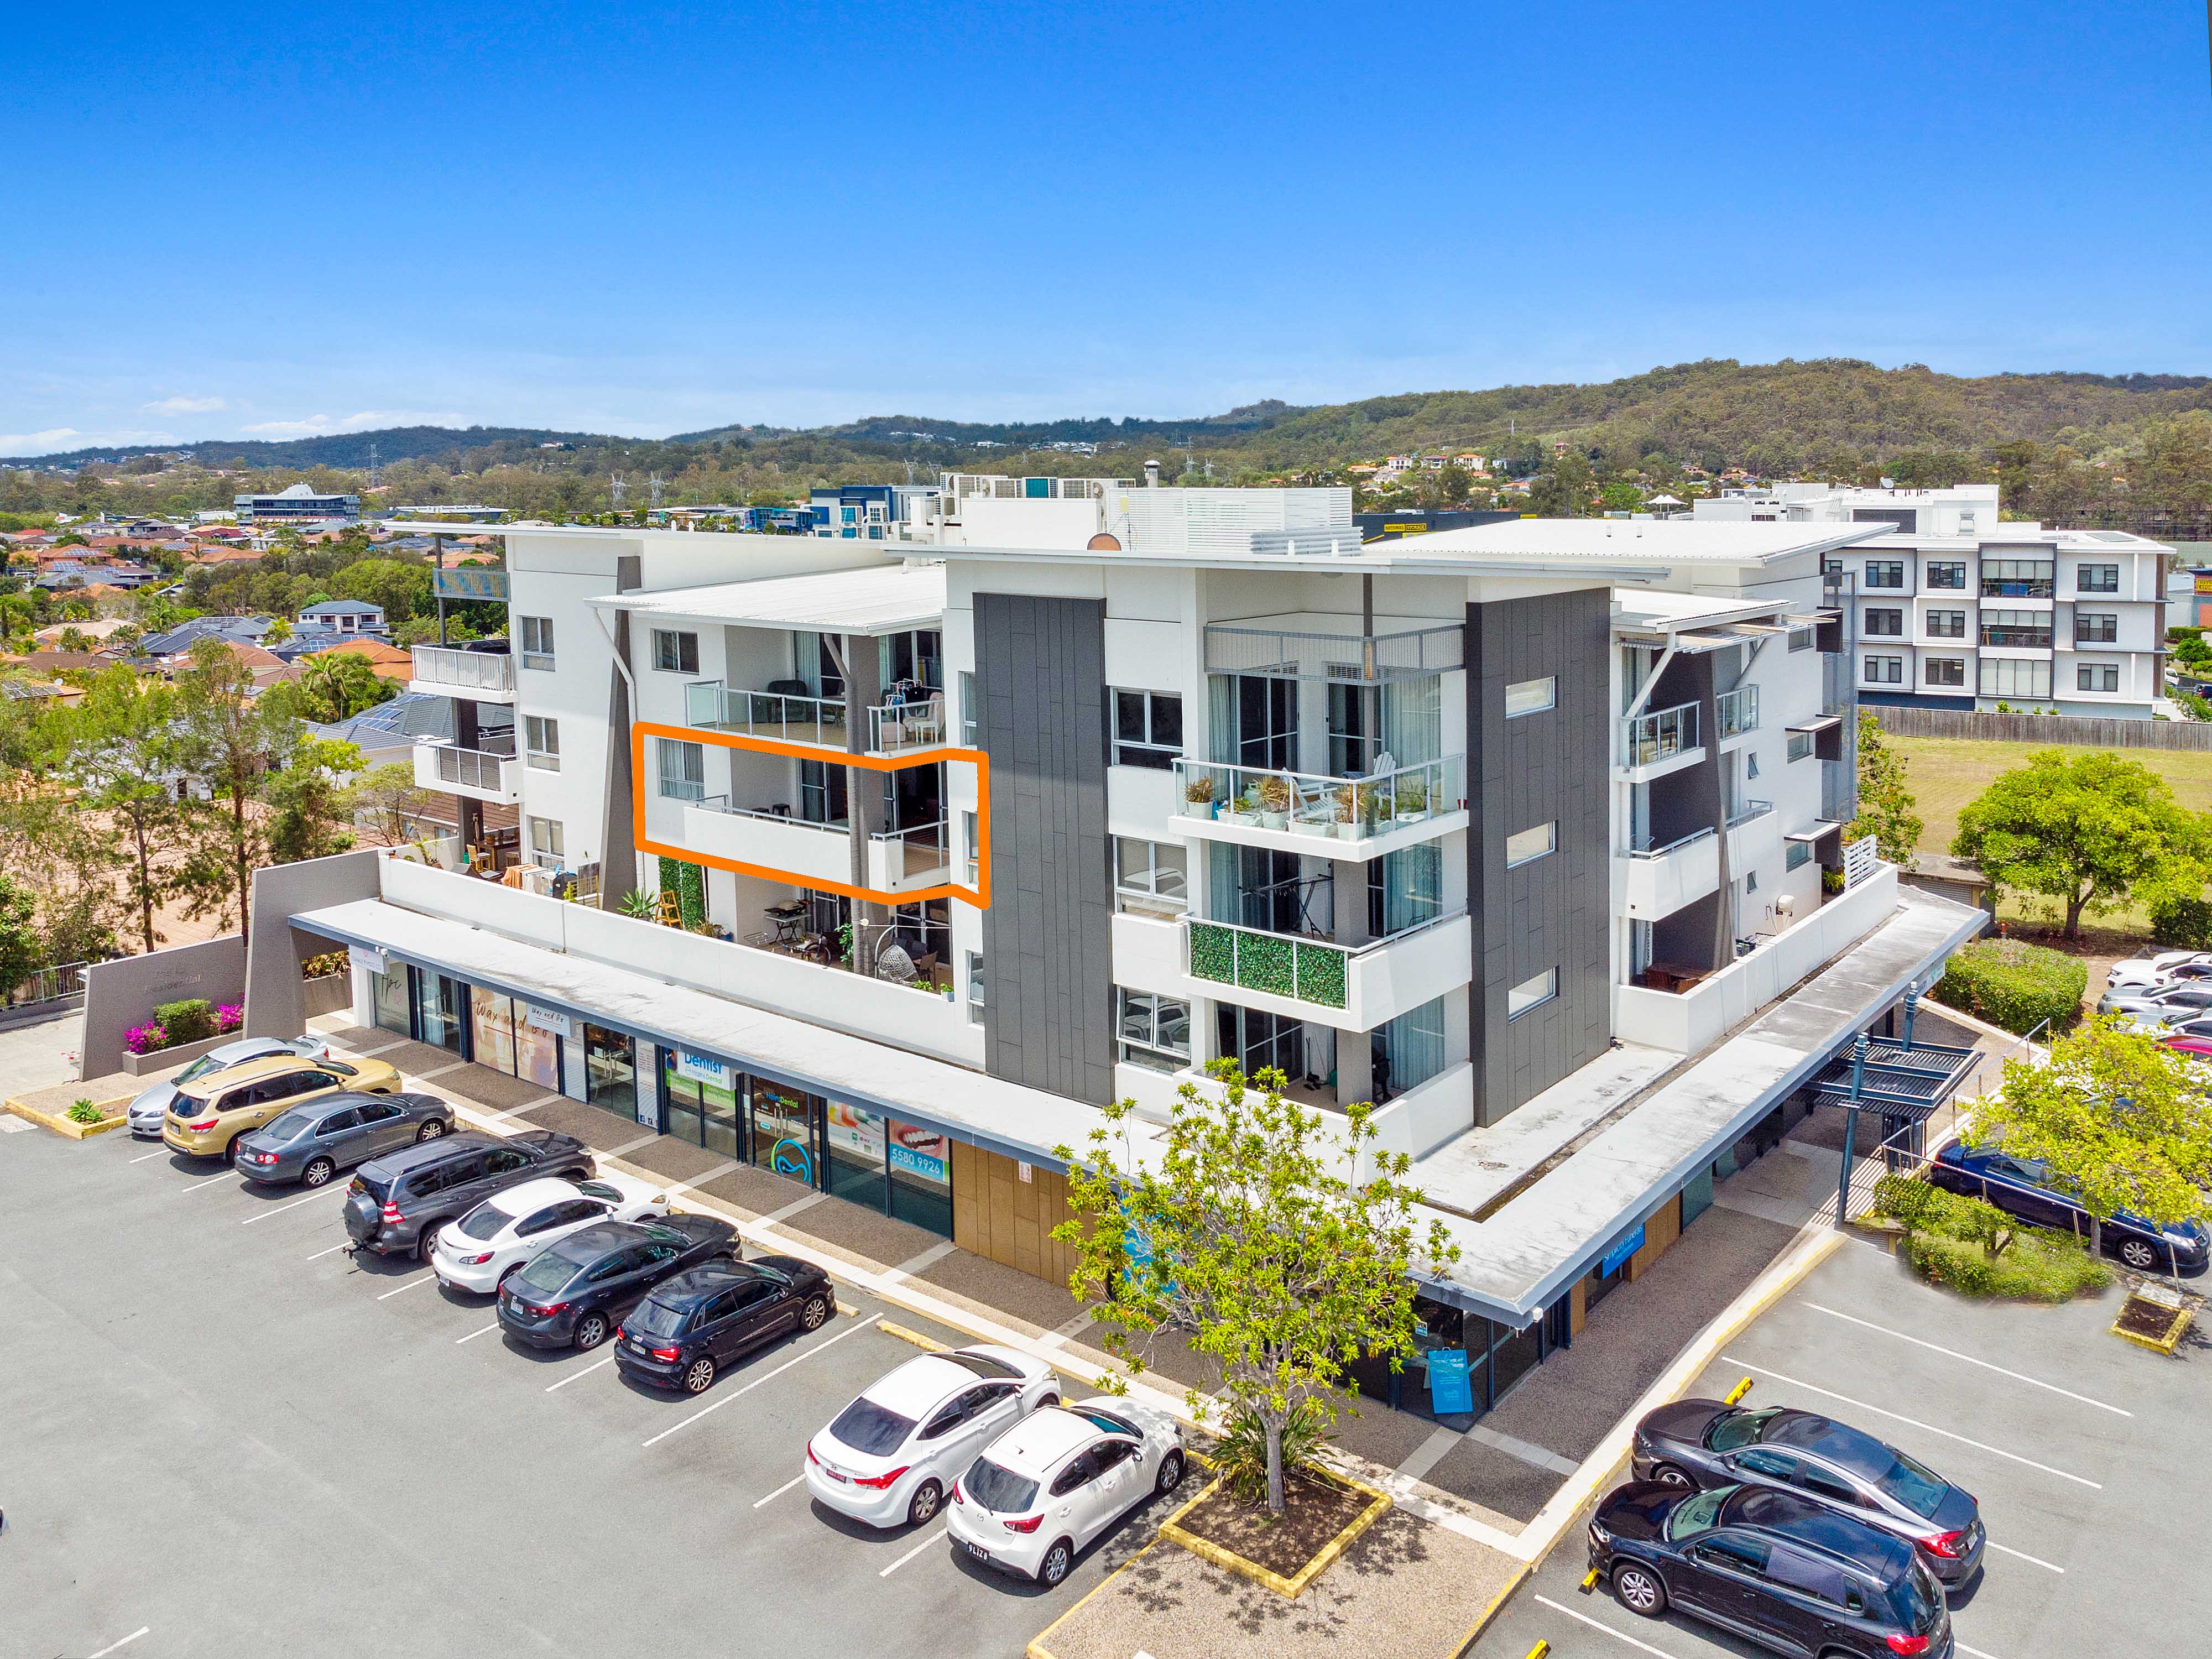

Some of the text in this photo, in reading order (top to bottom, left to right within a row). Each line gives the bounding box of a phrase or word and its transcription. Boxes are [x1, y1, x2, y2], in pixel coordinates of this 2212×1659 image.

[684, 1052, 723, 1074] Dentist
[892, 1148, 915, 1165] 5580
[917, 1157, 941, 1174] 9926
